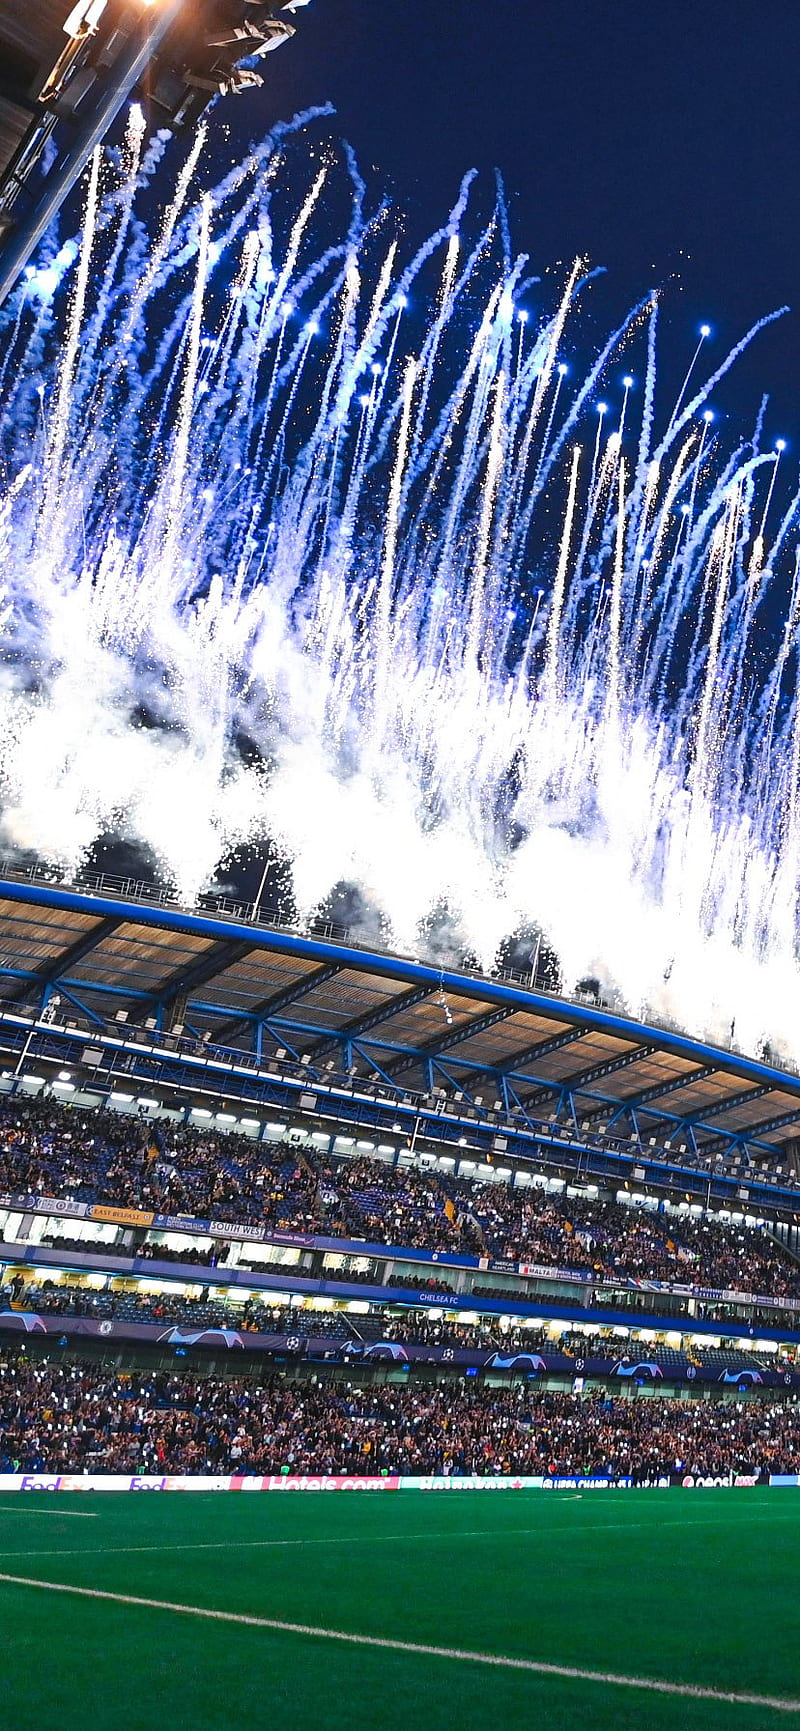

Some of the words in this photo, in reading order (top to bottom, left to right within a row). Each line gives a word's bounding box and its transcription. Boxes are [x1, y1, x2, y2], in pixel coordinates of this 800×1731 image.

[94, 1208, 112, 1216] EAST
[112, 1211, 140, 1220] BELFAST
[211, 1221, 240, 1233] SOUTH
[242, 1225, 265, 1236] WEST
[529, 1267, 551, 1276] MALTA
[419, 1293, 449, 1303] CHELSEA
[449, 1296, 459, 1304] FC
[21, 1476, 85, 1491] FedEx
[129, 1477, 188, 1491] FedEx
[268, 1475, 386, 1490] Hotelscom
[419, 1476, 508, 1490] Heineken
